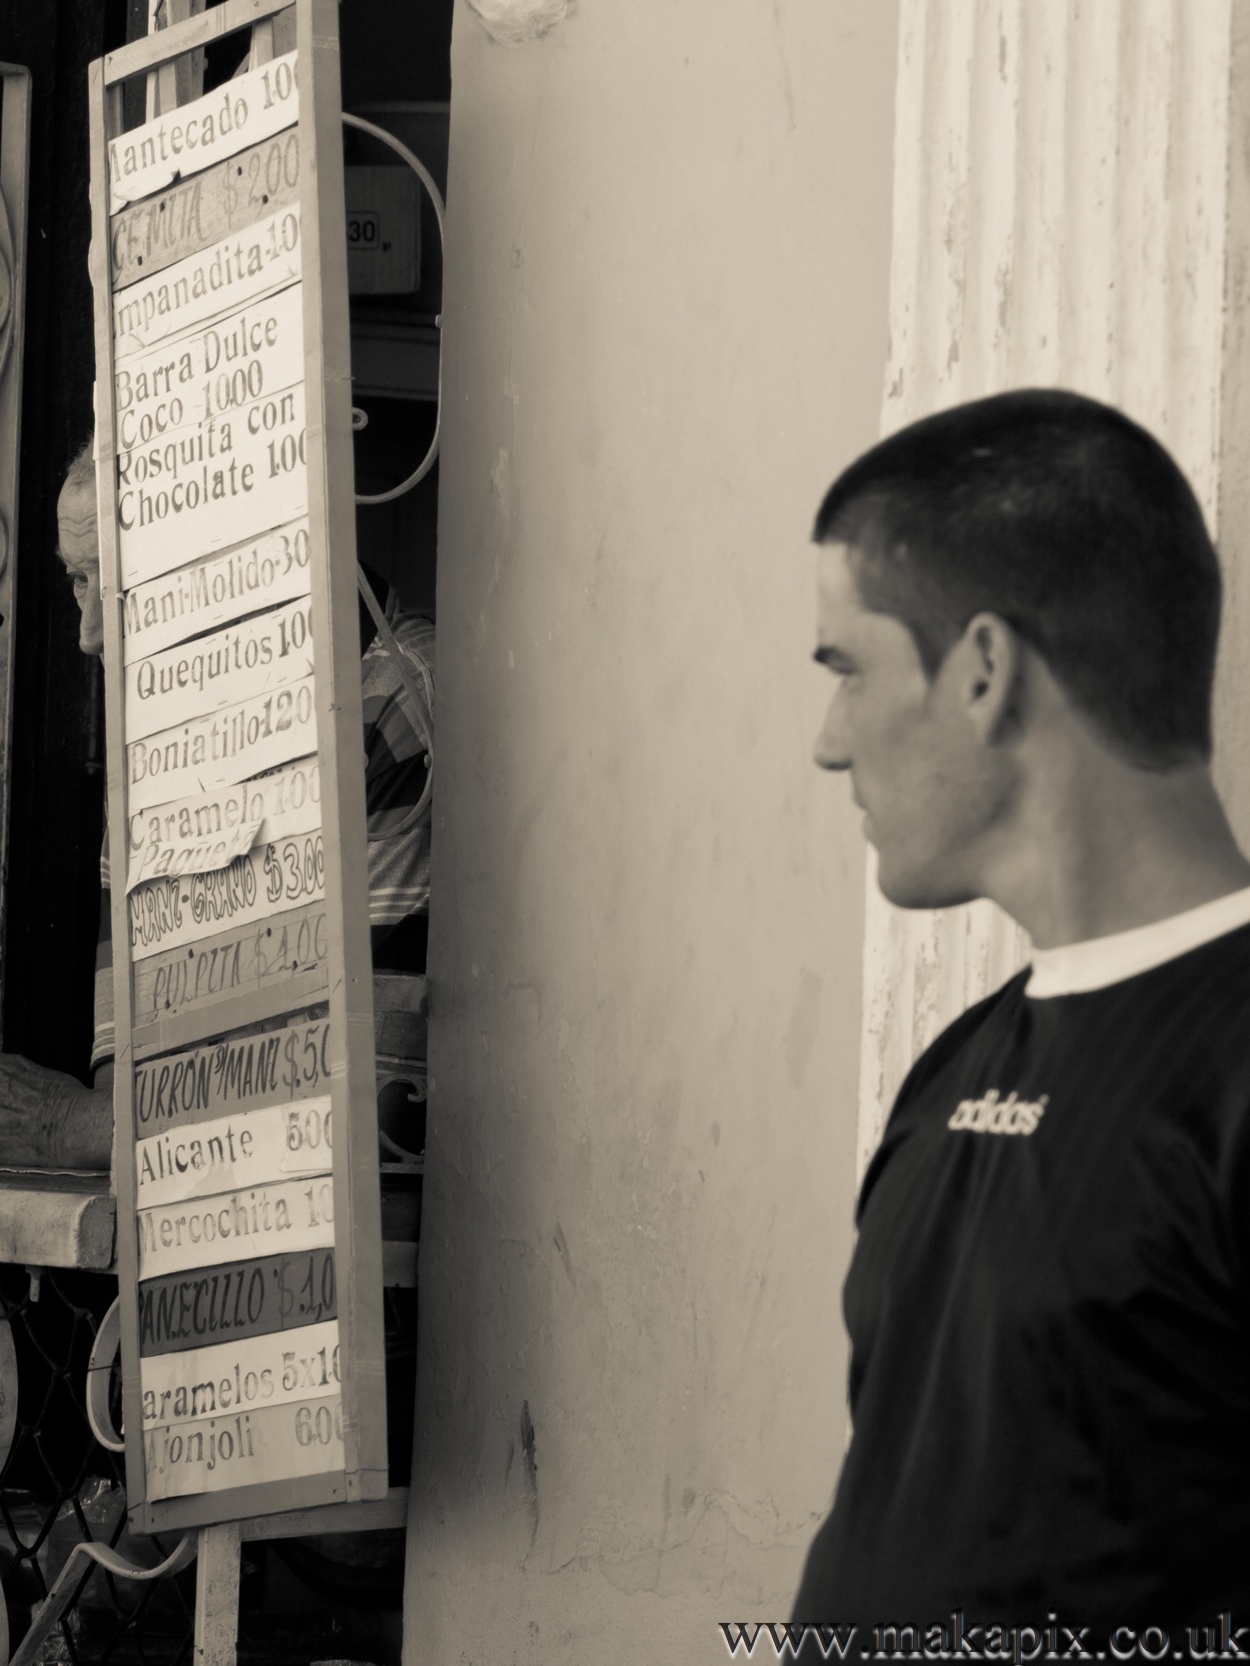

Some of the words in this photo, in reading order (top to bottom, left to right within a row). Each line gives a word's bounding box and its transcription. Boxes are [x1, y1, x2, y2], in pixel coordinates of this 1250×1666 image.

[114, 352, 194, 412] Barra
[203, 316, 278, 374] Dulce
[118, 418, 233, 486] Rosquita
[248, 393, 295, 435] con
[121, 397, 183, 450] Coco
[118, 457, 254, 531] Chocolate
[137, 634, 272, 700] Quequitos
[130, 782, 264, 851] Caramelo
[948, 1089, 1044, 1136] adidas
[140, 1125, 253, 1185] Alicante
[141, 1192, 291, 1253] Mercochita
